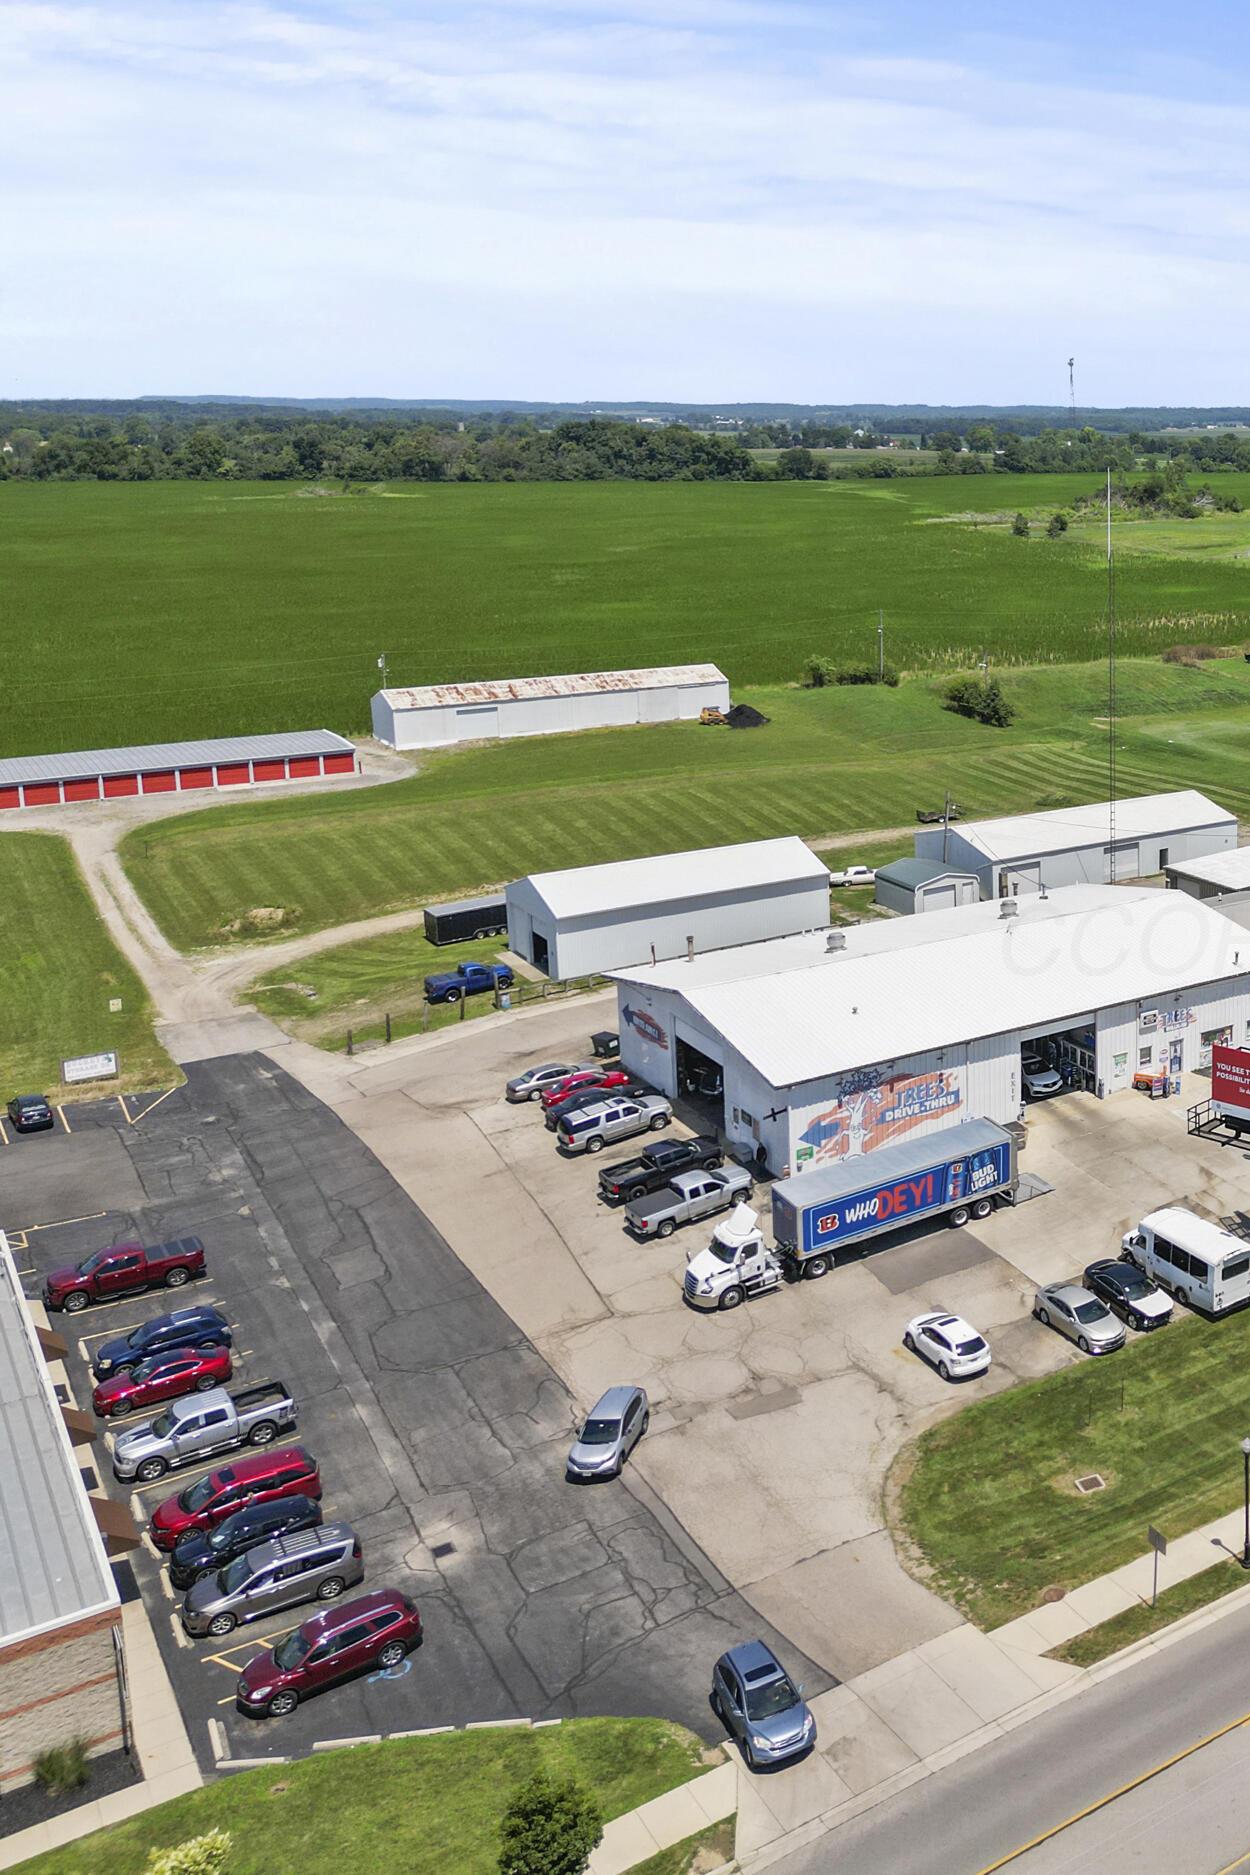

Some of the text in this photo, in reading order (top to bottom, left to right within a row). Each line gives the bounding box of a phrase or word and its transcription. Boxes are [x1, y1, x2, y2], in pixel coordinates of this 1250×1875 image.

[1216, 1062, 1231, 1071] YOU
[1231, 1065, 1245, 1075] SEE
[972, 1163, 995, 1181] BUD
[971, 1175, 998, 1192] LIGHT
[845, 1197, 879, 1224] WHO
[876, 1175, 933, 1220] DEY!
